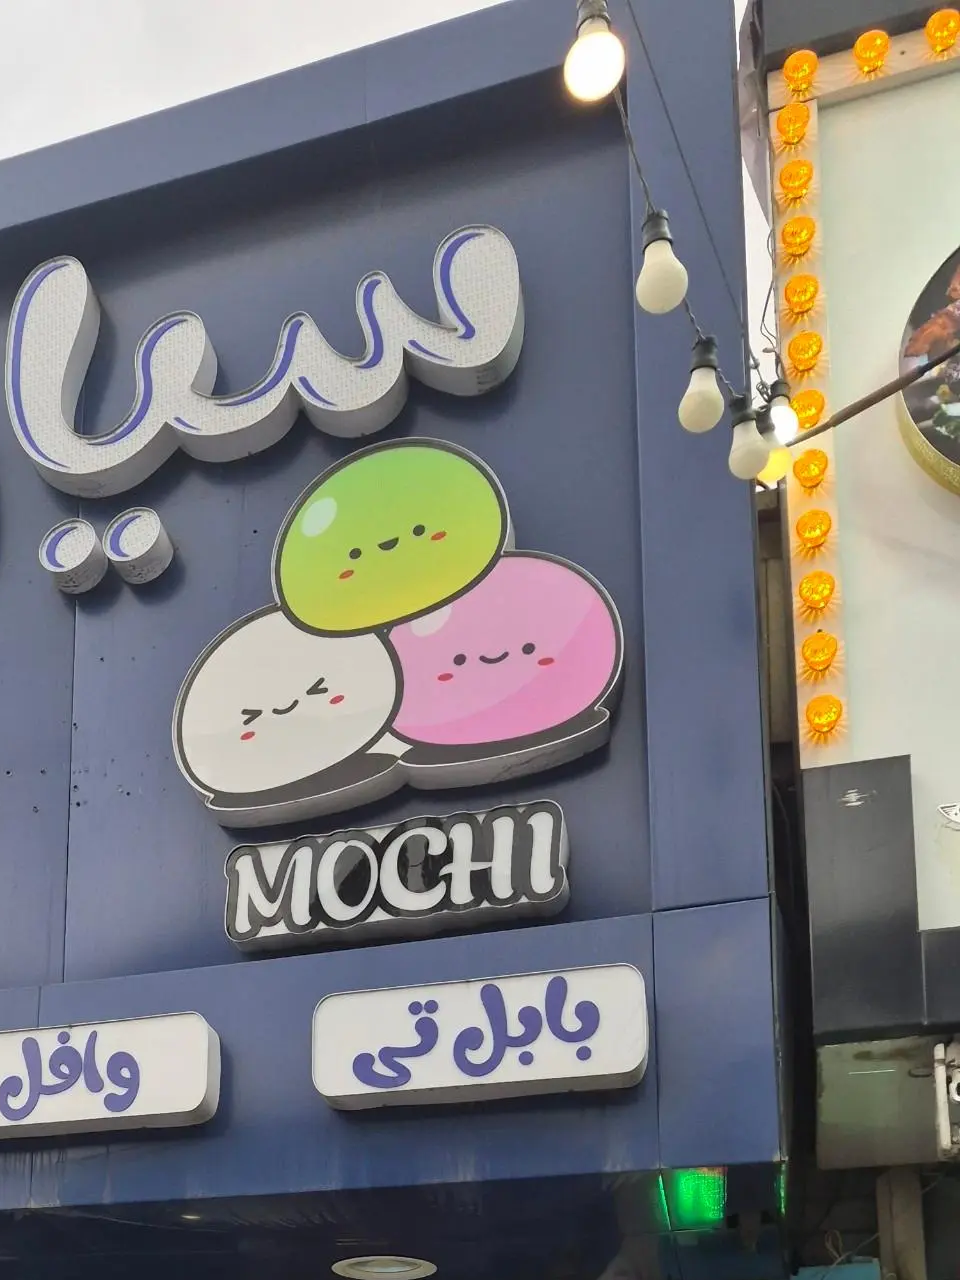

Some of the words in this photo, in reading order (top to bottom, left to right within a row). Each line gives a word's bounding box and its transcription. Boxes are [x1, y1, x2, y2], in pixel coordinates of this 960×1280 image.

[233, 808, 558, 935] MOCHI
[351, 999, 439, 1089] تی
[452, 975, 601, 1078] بابل
